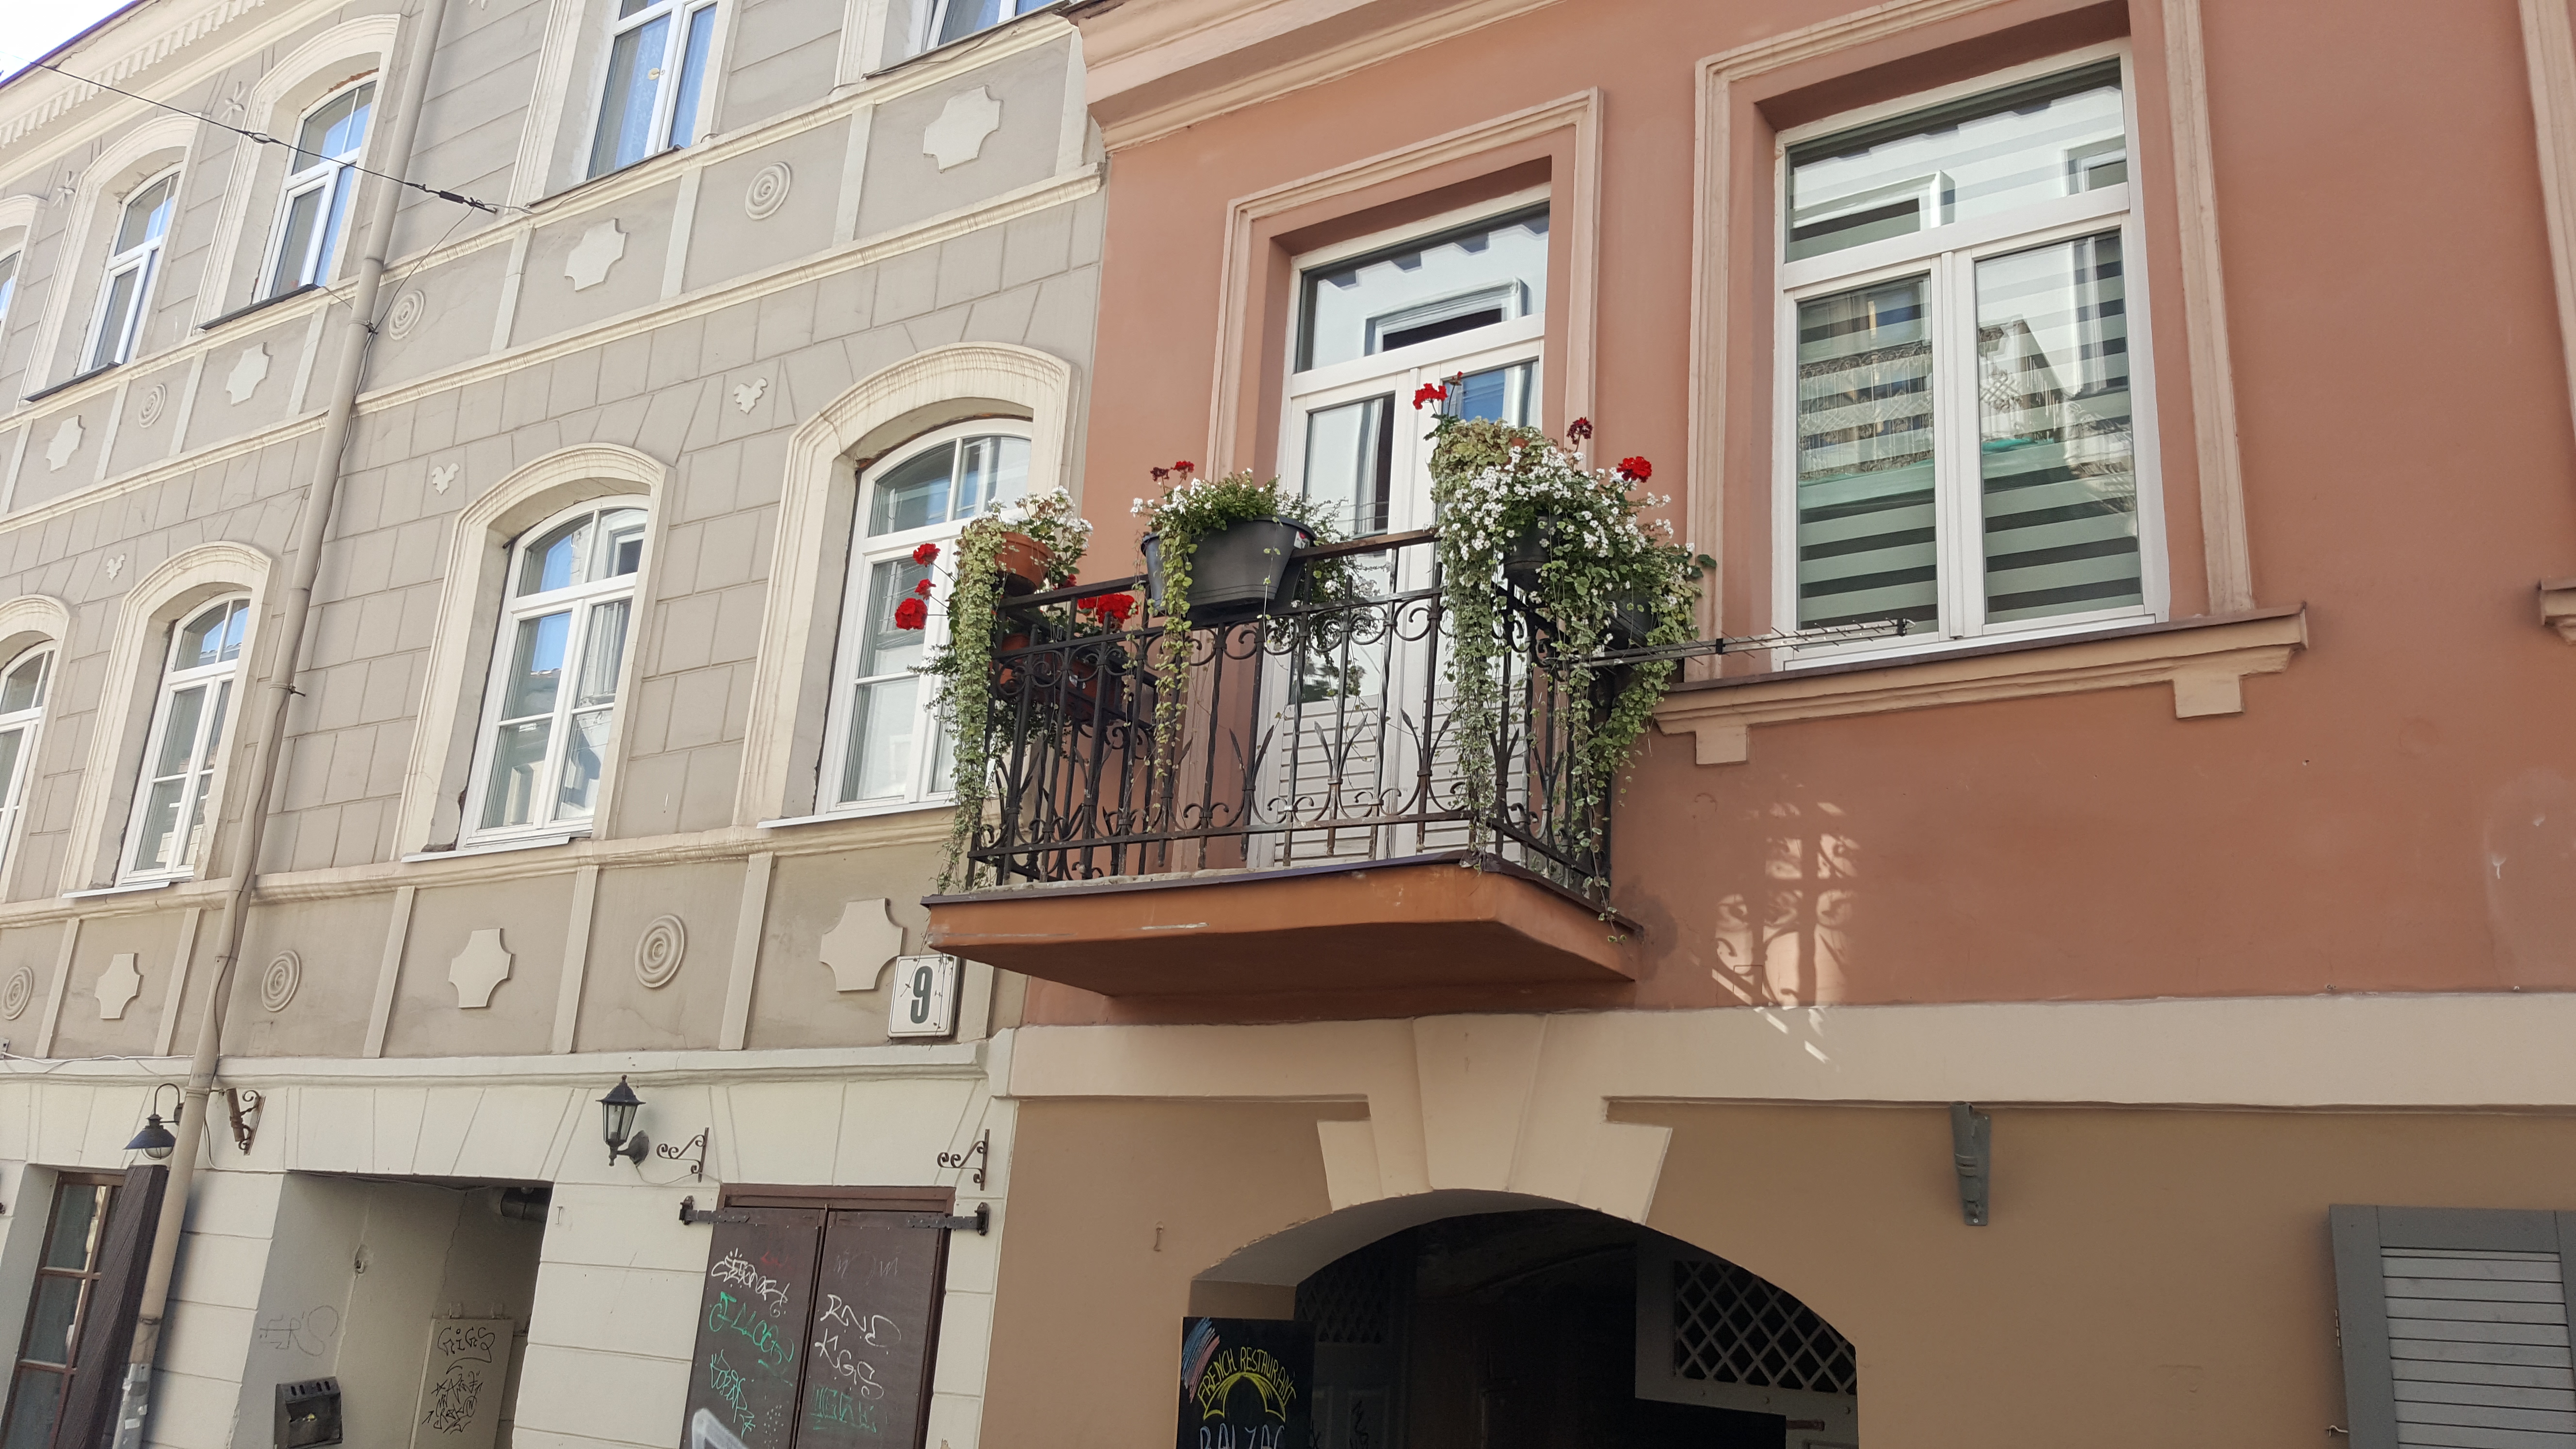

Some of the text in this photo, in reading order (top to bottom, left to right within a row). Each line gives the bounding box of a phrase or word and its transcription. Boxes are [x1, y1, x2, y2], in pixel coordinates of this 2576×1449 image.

[910, 966, 933, 1024] 9
[1197, 1347, 1297, 1408] FRENCH RESTAURANT
